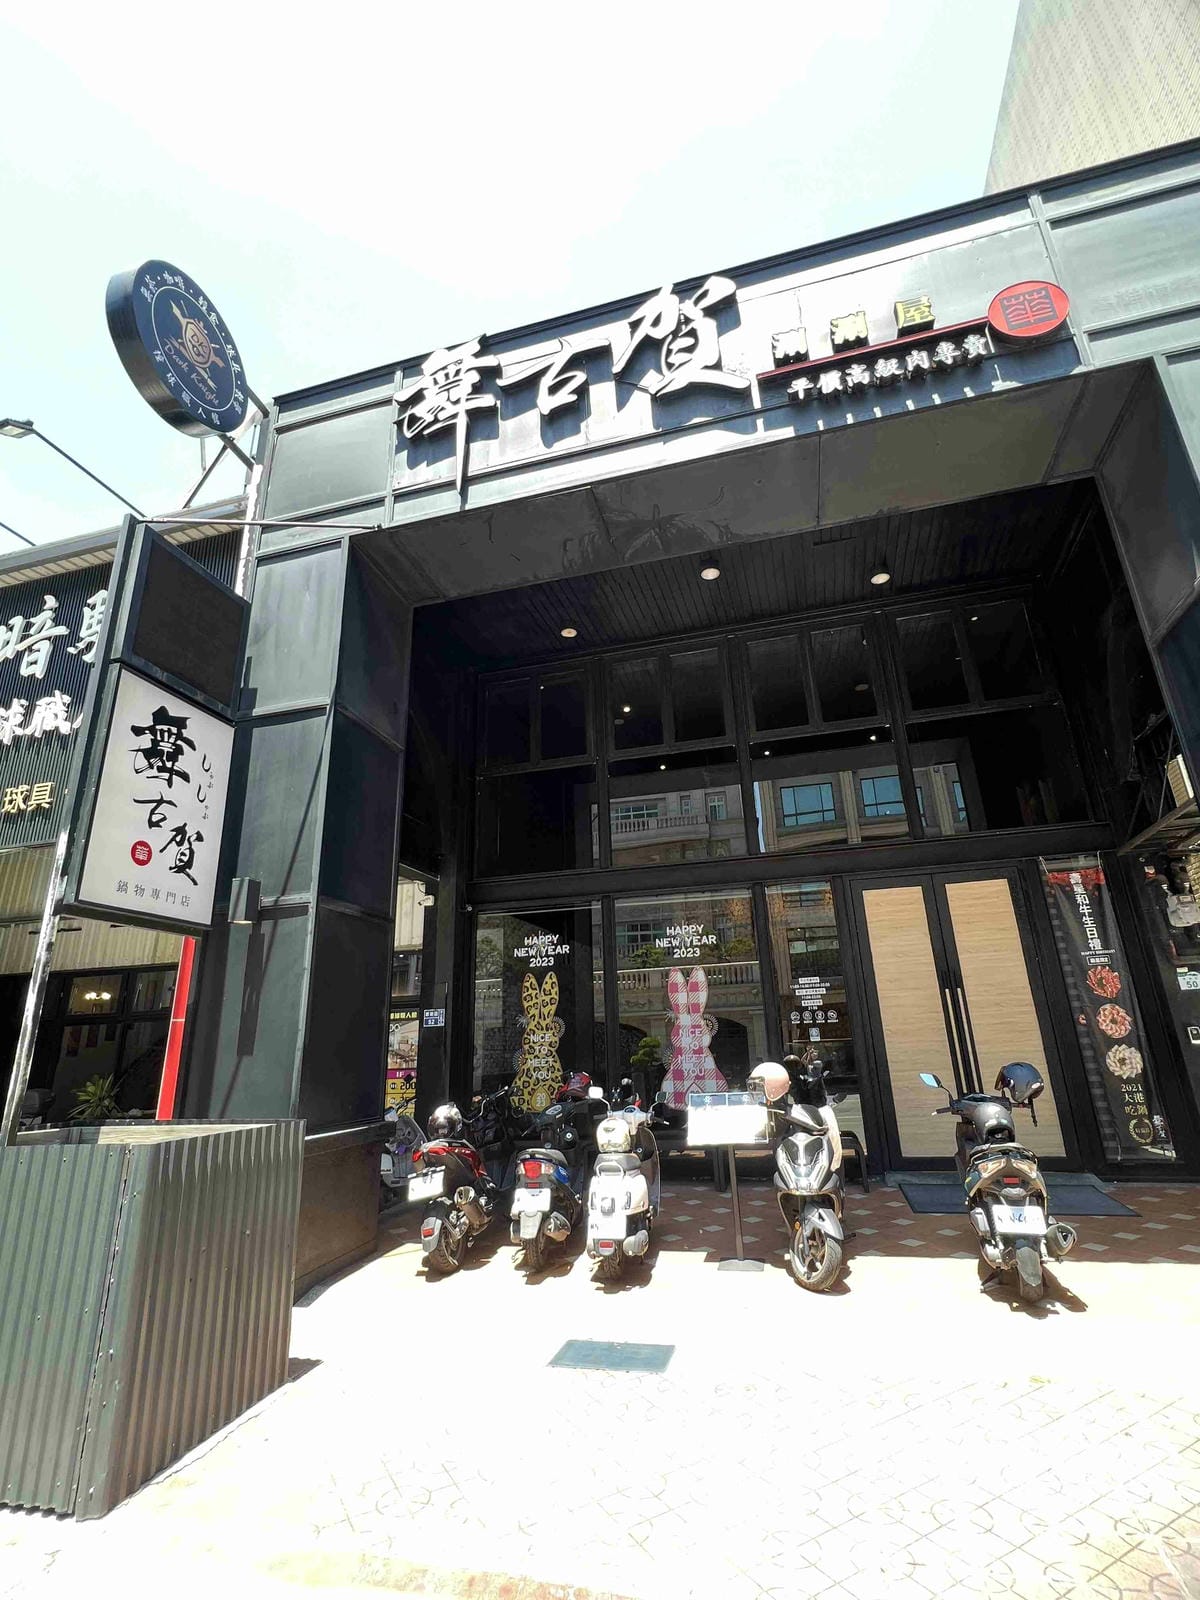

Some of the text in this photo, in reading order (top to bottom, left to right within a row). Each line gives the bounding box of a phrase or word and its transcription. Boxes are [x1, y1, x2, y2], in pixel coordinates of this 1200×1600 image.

[1, 782, 54, 813] 球具
[128, 705, 204, 887] 舞古賀
[116, 879, 191, 908] 鍋物專門店
[666, 924, 704, 936] HAPPY
[524, 934, 559, 946] HAPPY
[655, 935, 717, 948] NEW YEAR
[514, 944, 570, 957] NEW YEAR
[673, 947, 701, 958] 2023
[529, 956, 555, 967] 2023
[530, 1033, 551, 1042] NICE
[679, 1028, 702, 1037] NICE
[534, 1046, 548, 1054] TO
[527, 1058, 554, 1068] MEET
[532, 1071, 551, 1080] YOU
[1121, 1083, 1143, 1092] 2021
